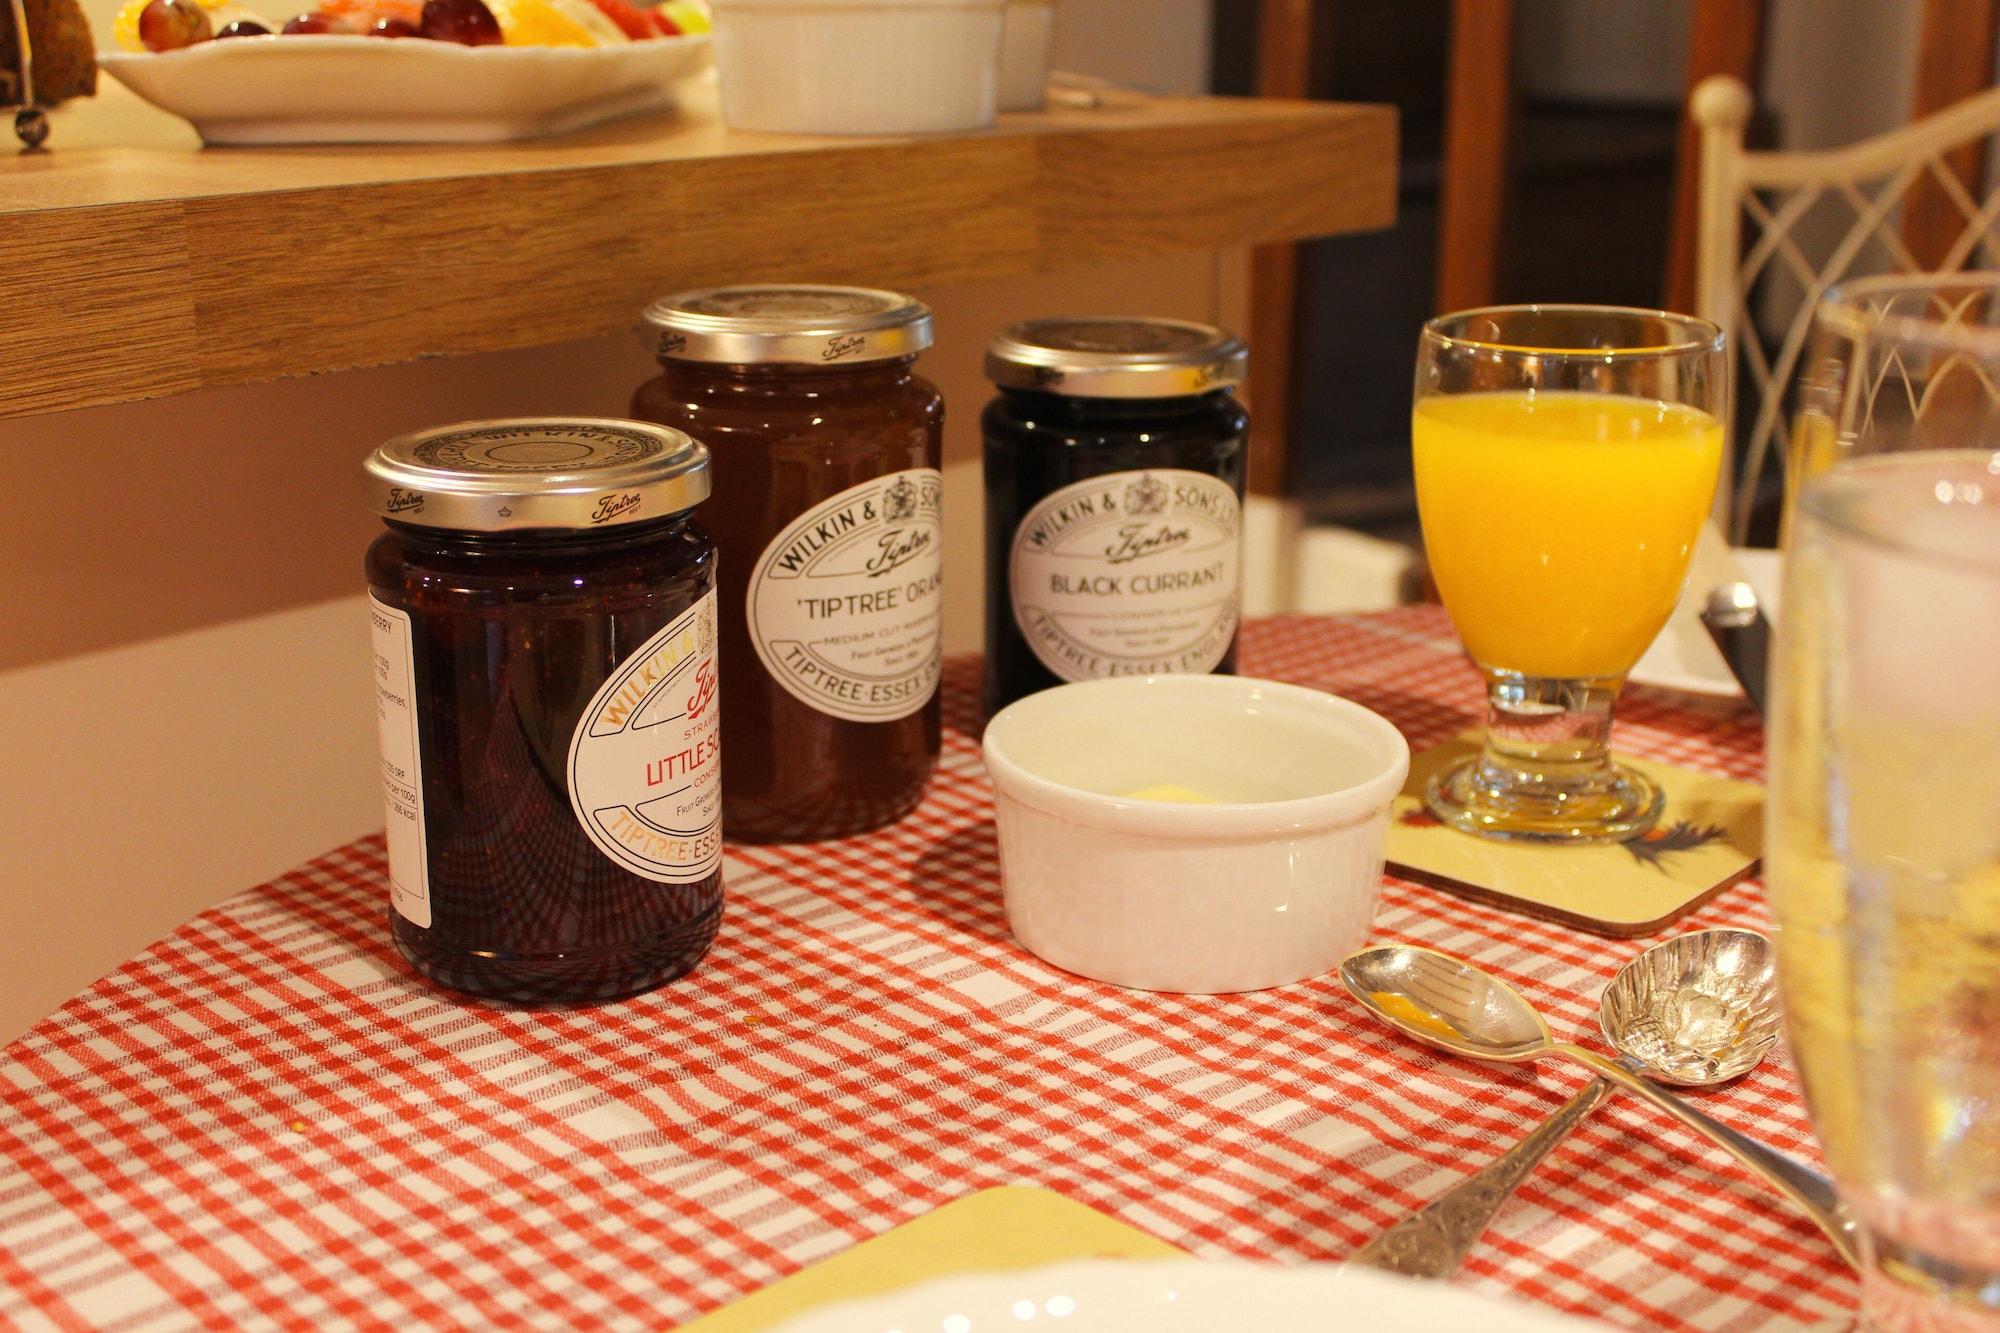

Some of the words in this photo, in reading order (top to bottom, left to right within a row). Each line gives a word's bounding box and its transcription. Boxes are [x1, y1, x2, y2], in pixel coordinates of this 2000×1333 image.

[387, 488, 424, 513] Tiptree
[592, 493, 641, 524] Tiptree
[1031, 498, 1094, 547] WILKIN
[1103, 493, 1115, 510] &
[1175, 486, 1219, 516] SONS
[779, 509, 856, 572] WILKIN
[863, 501, 876, 520] &
[865, 529, 931, 578] Tiptree
[1105, 523, 1190, 564] Tiptree
[1051, 574, 1122, 596] BLACK
[1130, 561, 1224, 594] CURRANT
[824, 631, 875, 646] MEDIUM
[600, 642, 678, 727] WILKIN
[785, 645, 865, 700] TIPTREE
[871, 677, 920, 703] ESSEX
[646, 741, 705, 786] LITTLE
[611, 810, 689, 861] TIPTREE
